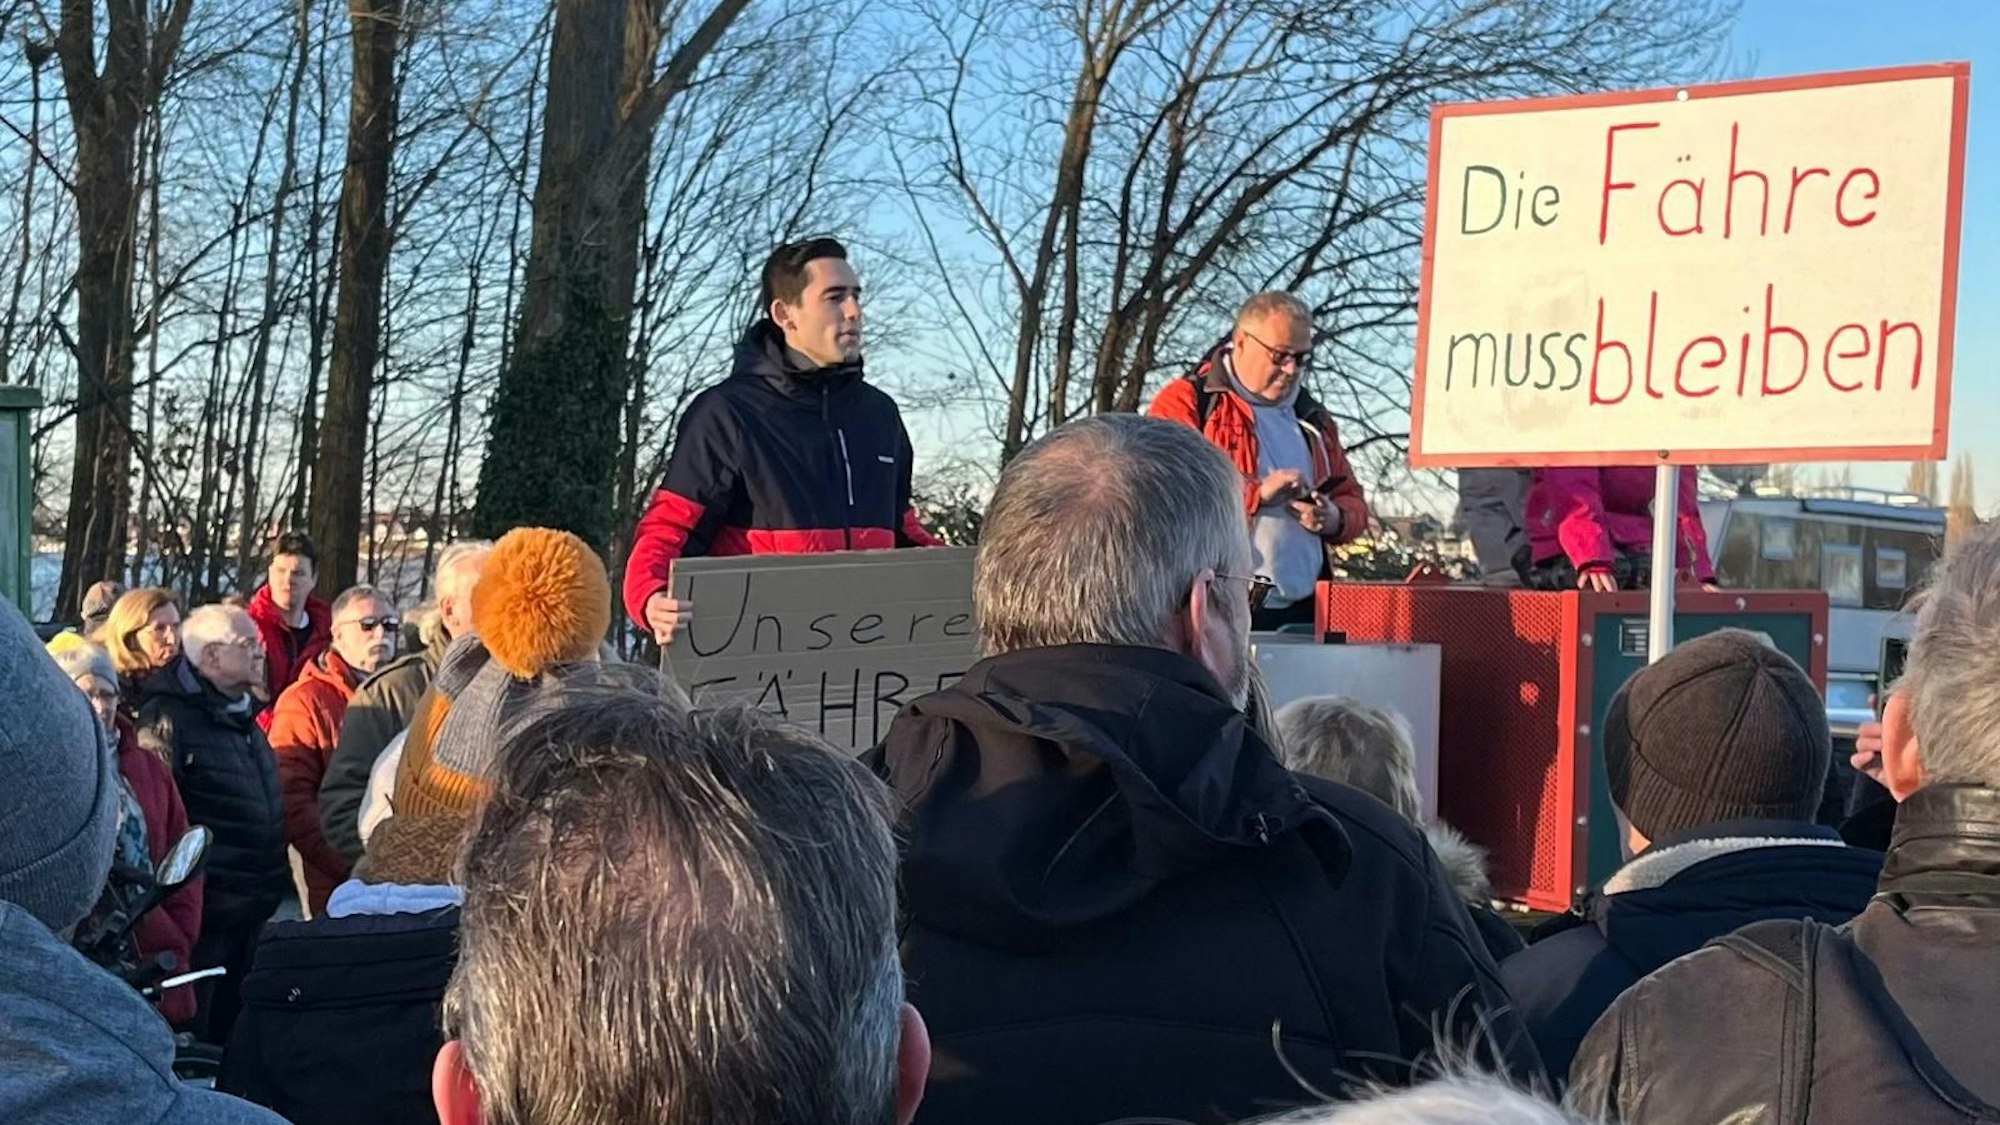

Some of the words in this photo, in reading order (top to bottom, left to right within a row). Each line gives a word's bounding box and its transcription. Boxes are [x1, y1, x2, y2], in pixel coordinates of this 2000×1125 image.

[1461, 165, 1560, 235] Die
[1599, 121, 1881, 245] Fähre
[1445, 331, 1587, 392] muss
[1589, 283, 1923, 406] bleiben
[688, 571, 971, 657] Unsere
